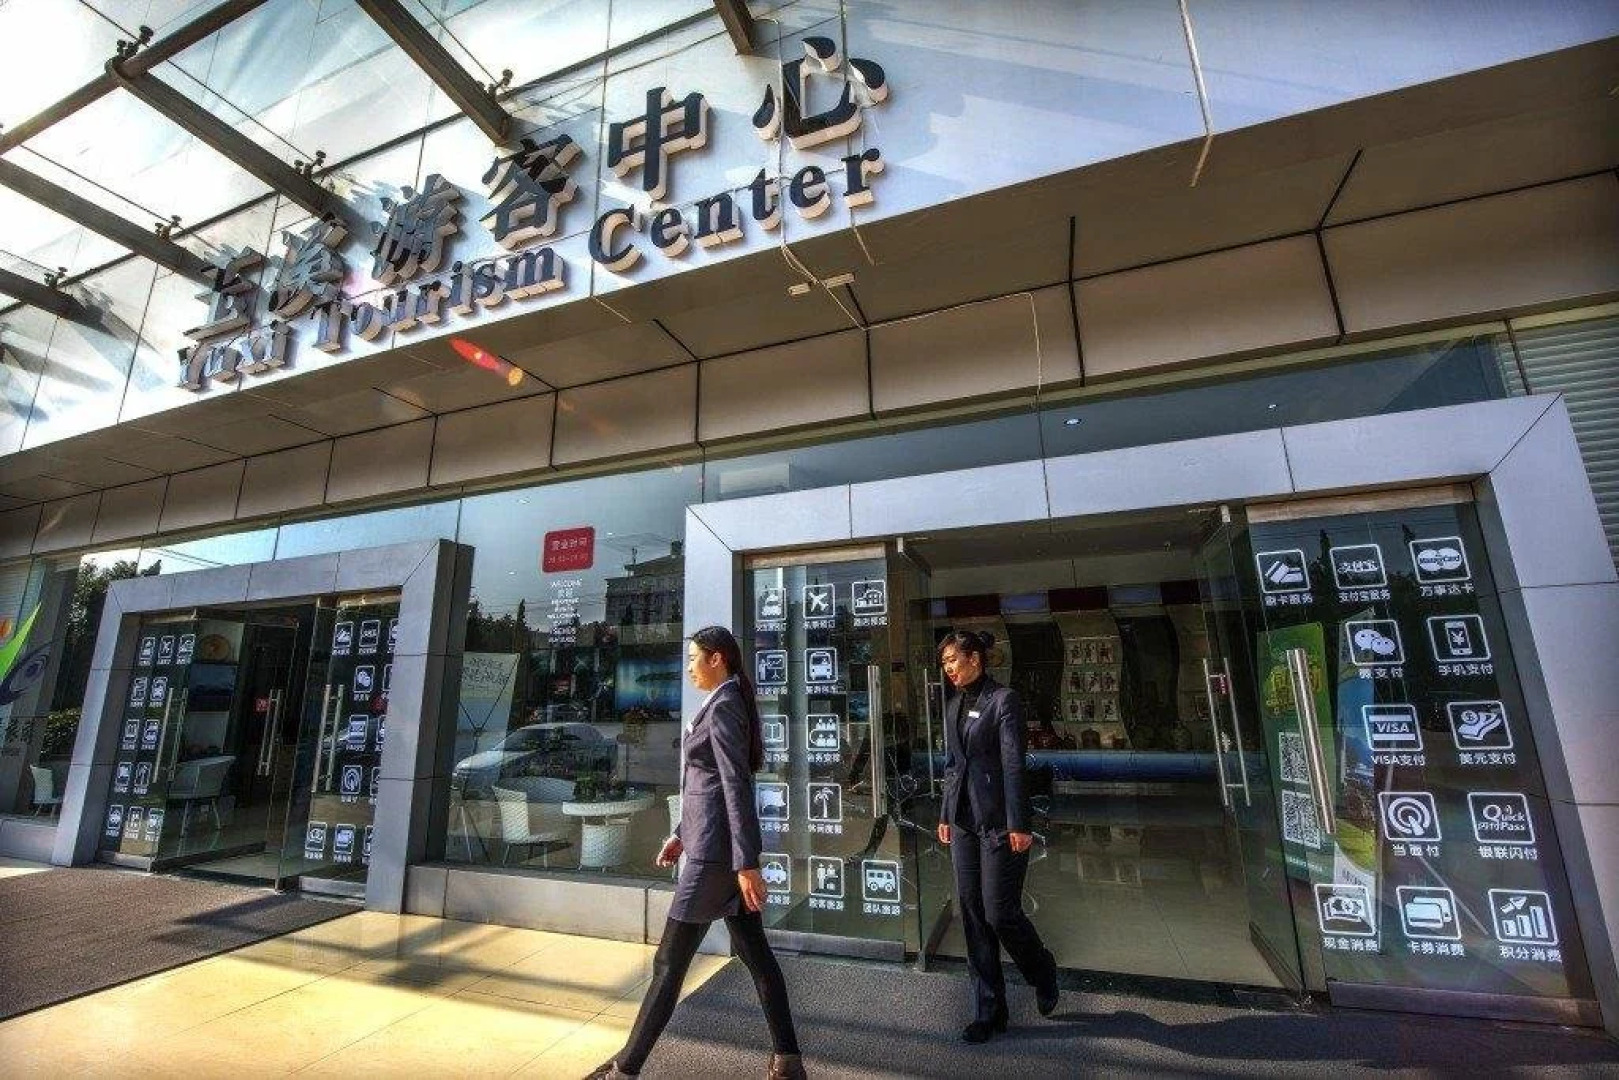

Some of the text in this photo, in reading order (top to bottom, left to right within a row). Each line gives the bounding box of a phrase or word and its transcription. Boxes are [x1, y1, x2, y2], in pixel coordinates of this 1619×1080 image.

[177, 143, 886, 392] Yuxi Tourism Center
[1338, 589, 1391, 603] 支付宝服务
[1420, 584, 1475, 597] 万事达卡
[1438, 663, 1493, 677] 手机支付
[1374, 721, 1411, 734] VISA
[1370, 753, 1425, 767] VISA支付
[1459, 752, 1517, 766] 美元支付
[1478, 846, 1538, 861] 银联闪付
[1323, 936, 1379, 952] 现金消费
[1499, 945, 1562, 963] 积分消费
